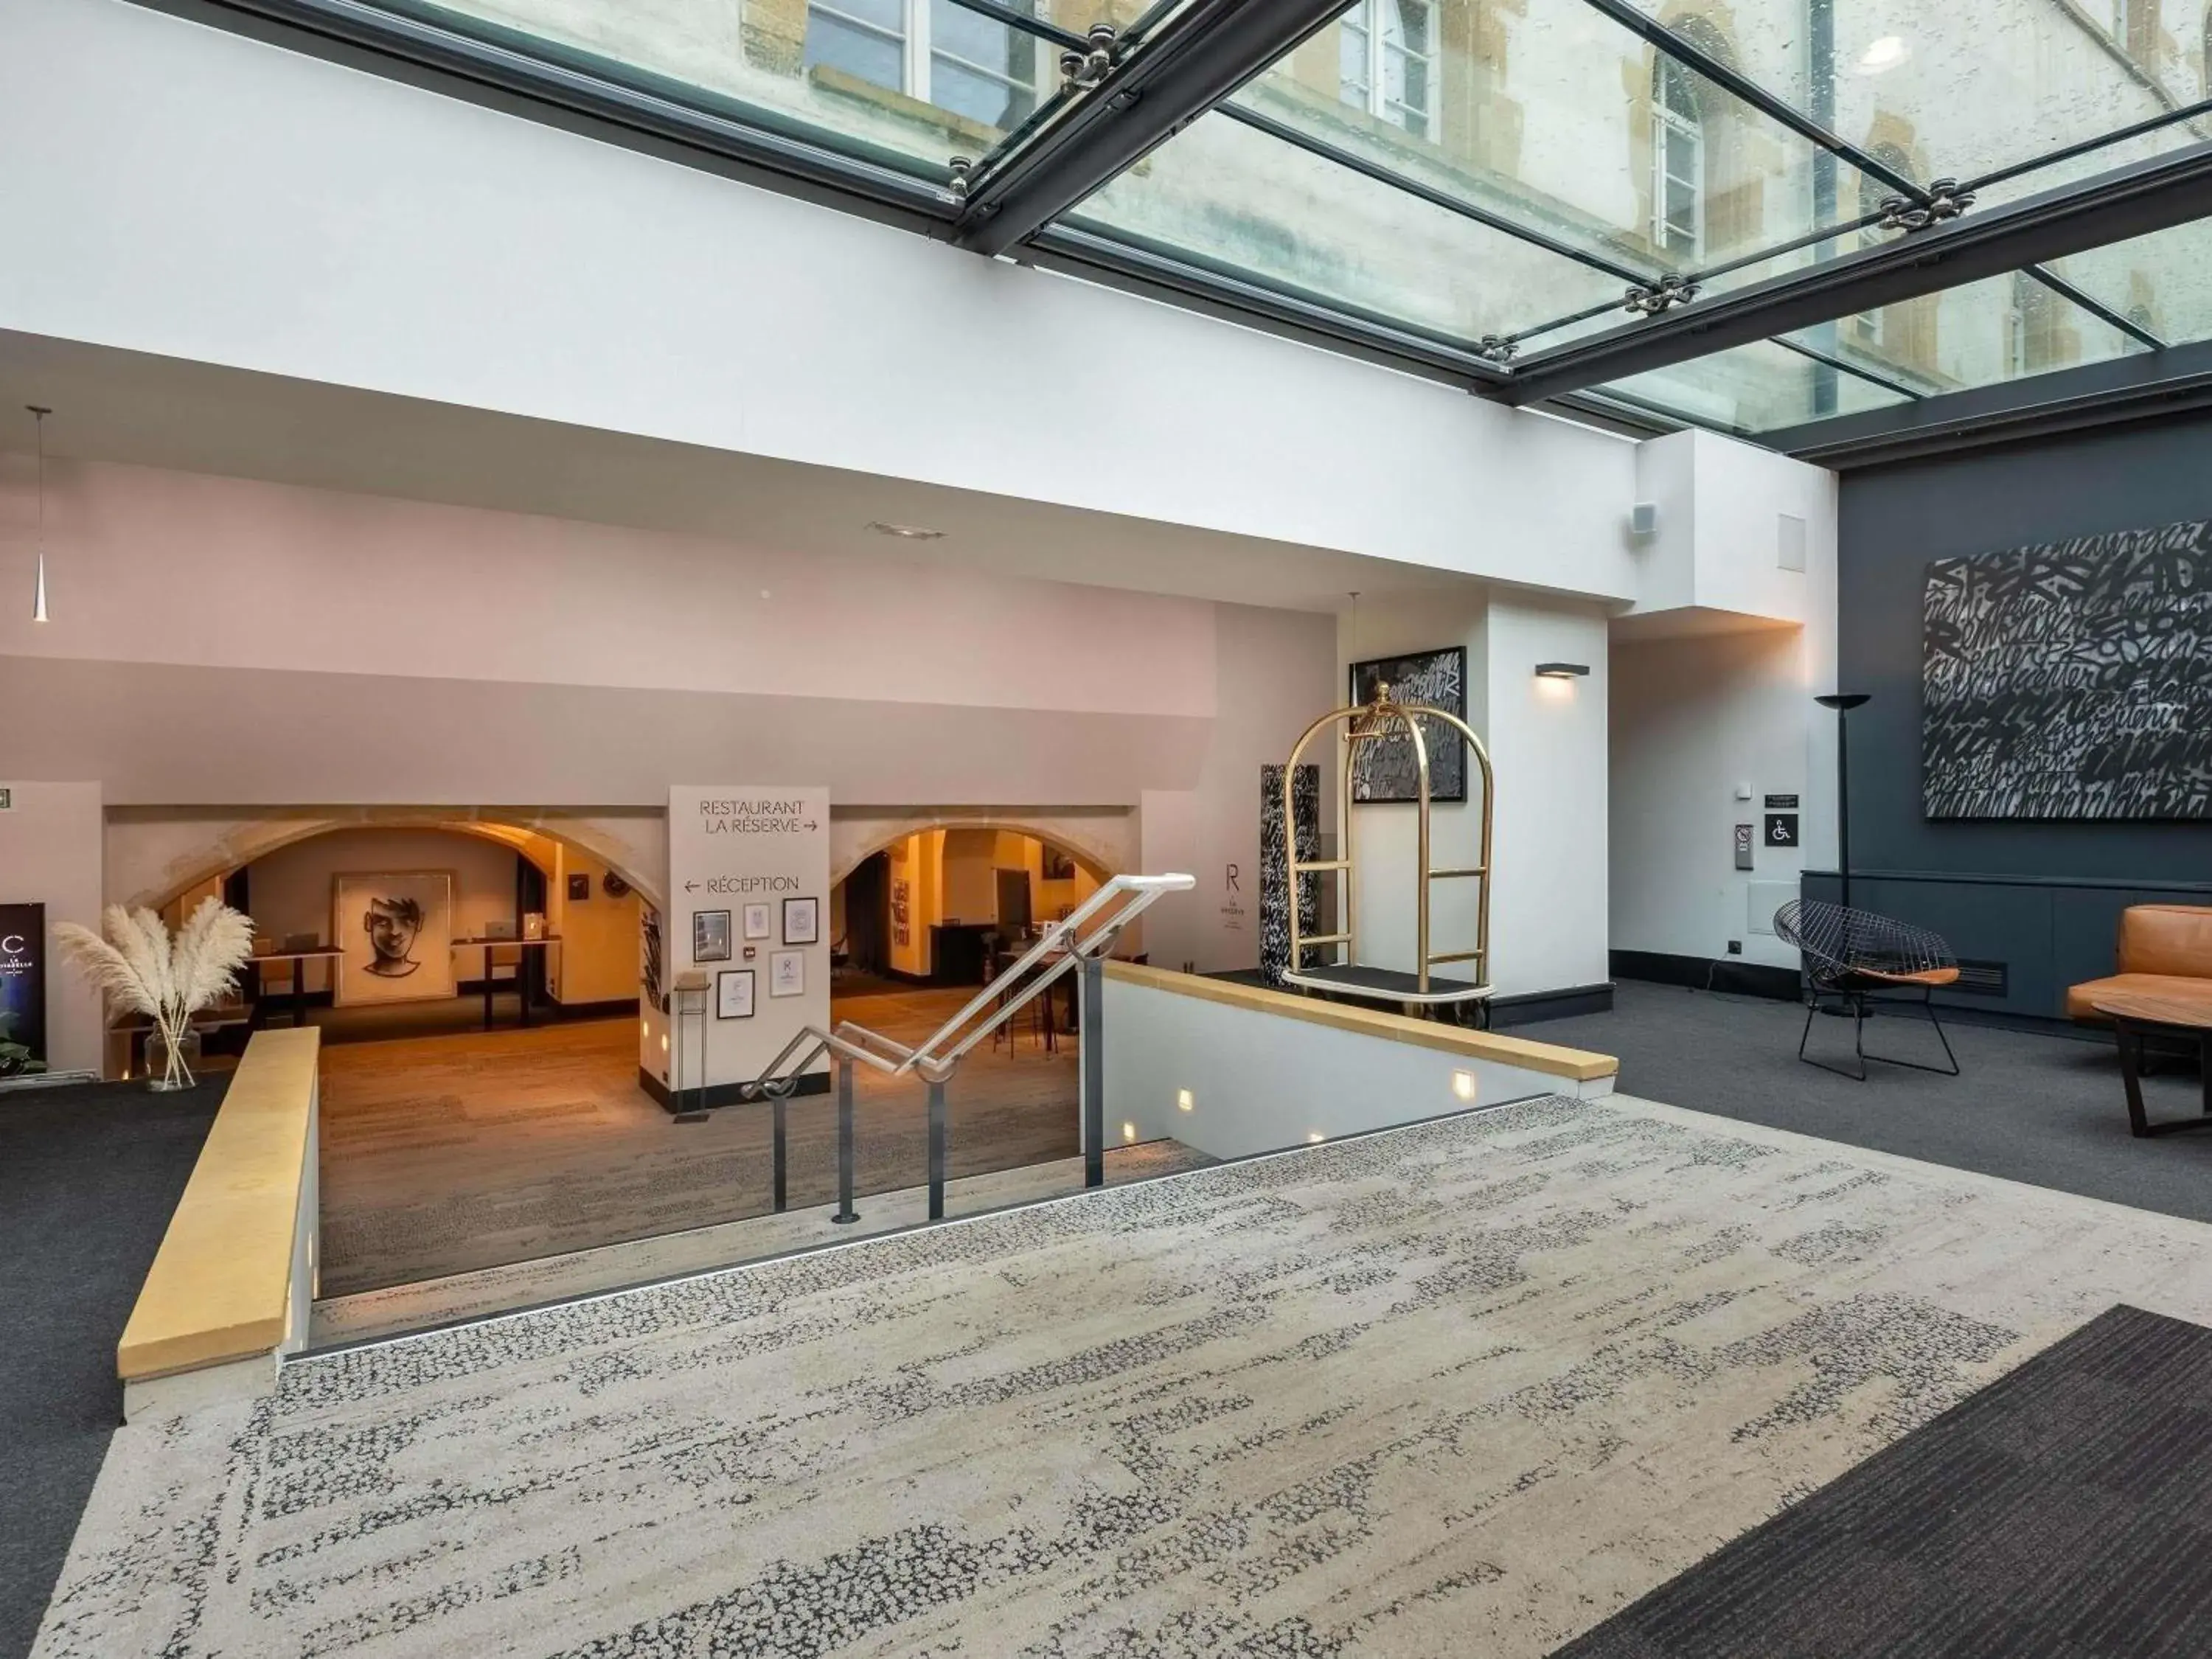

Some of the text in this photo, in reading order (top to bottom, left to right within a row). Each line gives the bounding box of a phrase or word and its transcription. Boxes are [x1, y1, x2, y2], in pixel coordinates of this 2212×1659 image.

[700, 800, 804, 815] RESTAURANT
[706, 815, 800, 834] LA RÉSERVE
[707, 875, 799, 894] RÉCEPTION
[1226, 863, 1239, 891] R
